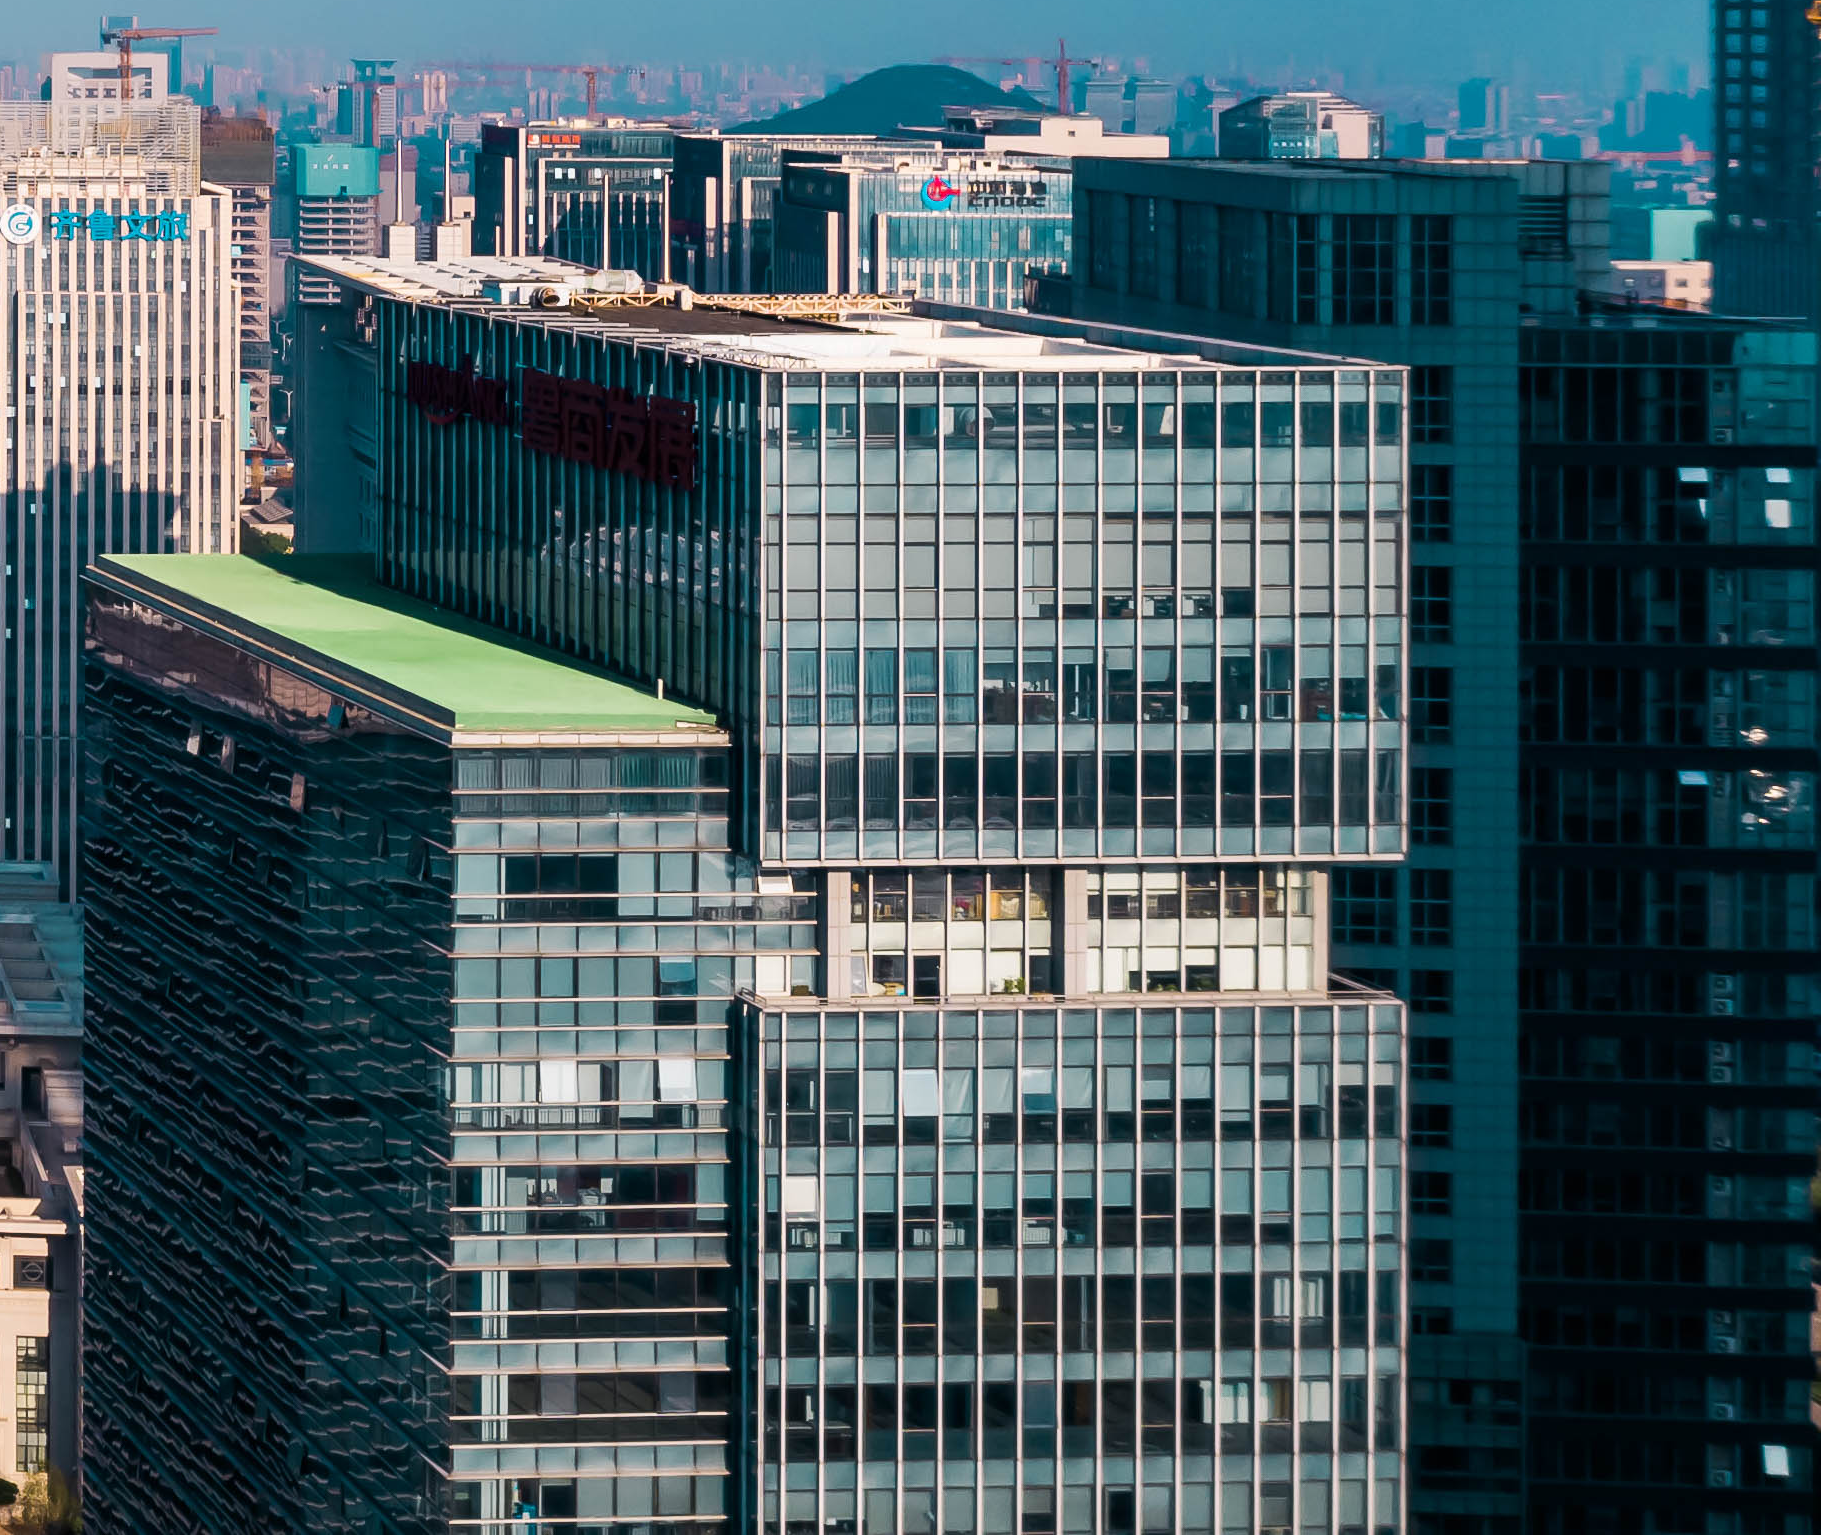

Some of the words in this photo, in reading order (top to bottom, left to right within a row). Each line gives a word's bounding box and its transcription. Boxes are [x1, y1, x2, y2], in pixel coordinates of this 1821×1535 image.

[50, 209, 188, 241] 齐鲁文旅
[523, 367, 696, 491] 鲁商发展
